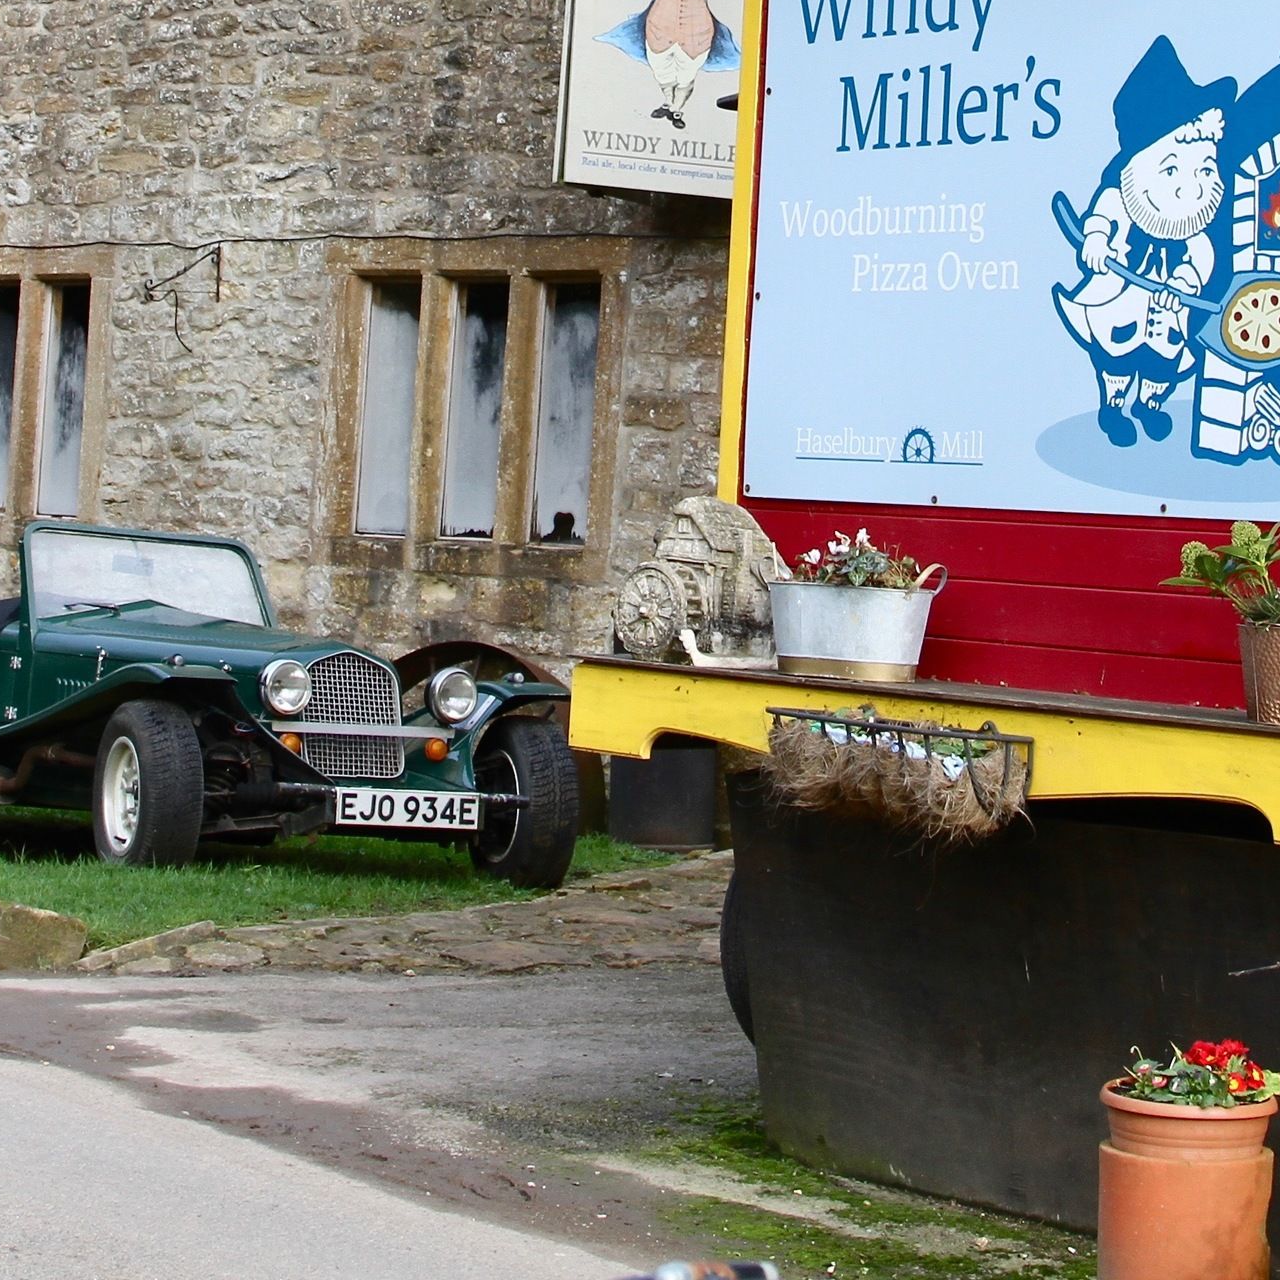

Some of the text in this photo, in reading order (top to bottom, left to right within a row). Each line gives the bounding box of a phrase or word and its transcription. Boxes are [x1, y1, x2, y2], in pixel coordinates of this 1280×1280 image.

[835, 54, 1062, 153] Miller's
[582, 130, 661, 154] WINDY
[581, 156, 599, 167] Real
[617, 160, 637, 171] local
[659, 165, 668, 174] &
[779, 192, 987, 244] Woodburning
[851, 250, 1020, 292] Pizza Oven
[795, 426, 984, 463] Haselbury Mill
[340, 793, 476, 825] EJO 934E
